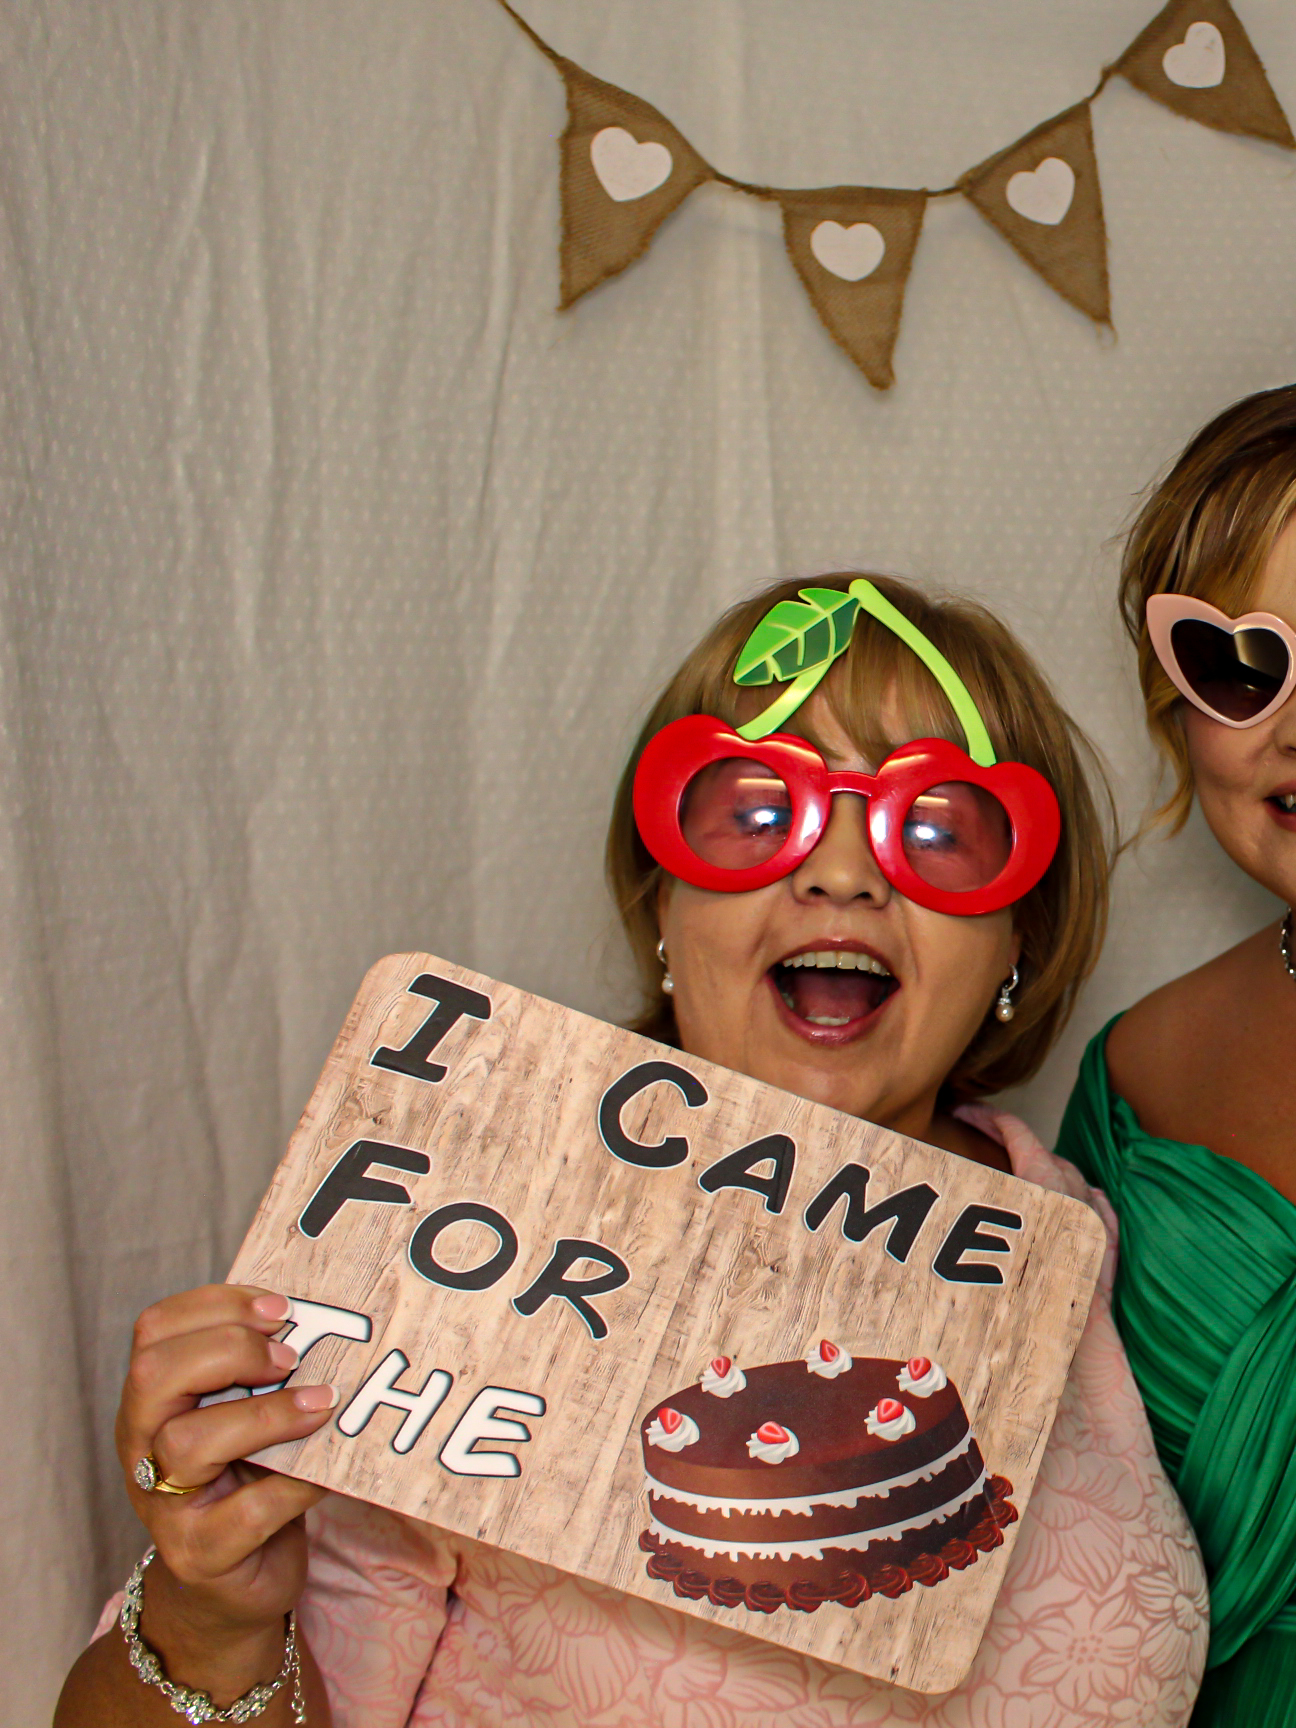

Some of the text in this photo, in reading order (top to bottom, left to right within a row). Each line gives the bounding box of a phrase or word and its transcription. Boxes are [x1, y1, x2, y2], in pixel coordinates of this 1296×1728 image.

[370, 972, 1023, 1285] I CAME
[298, 1138, 631, 1340] FOR
[249, 1297, 546, 1477] THE
